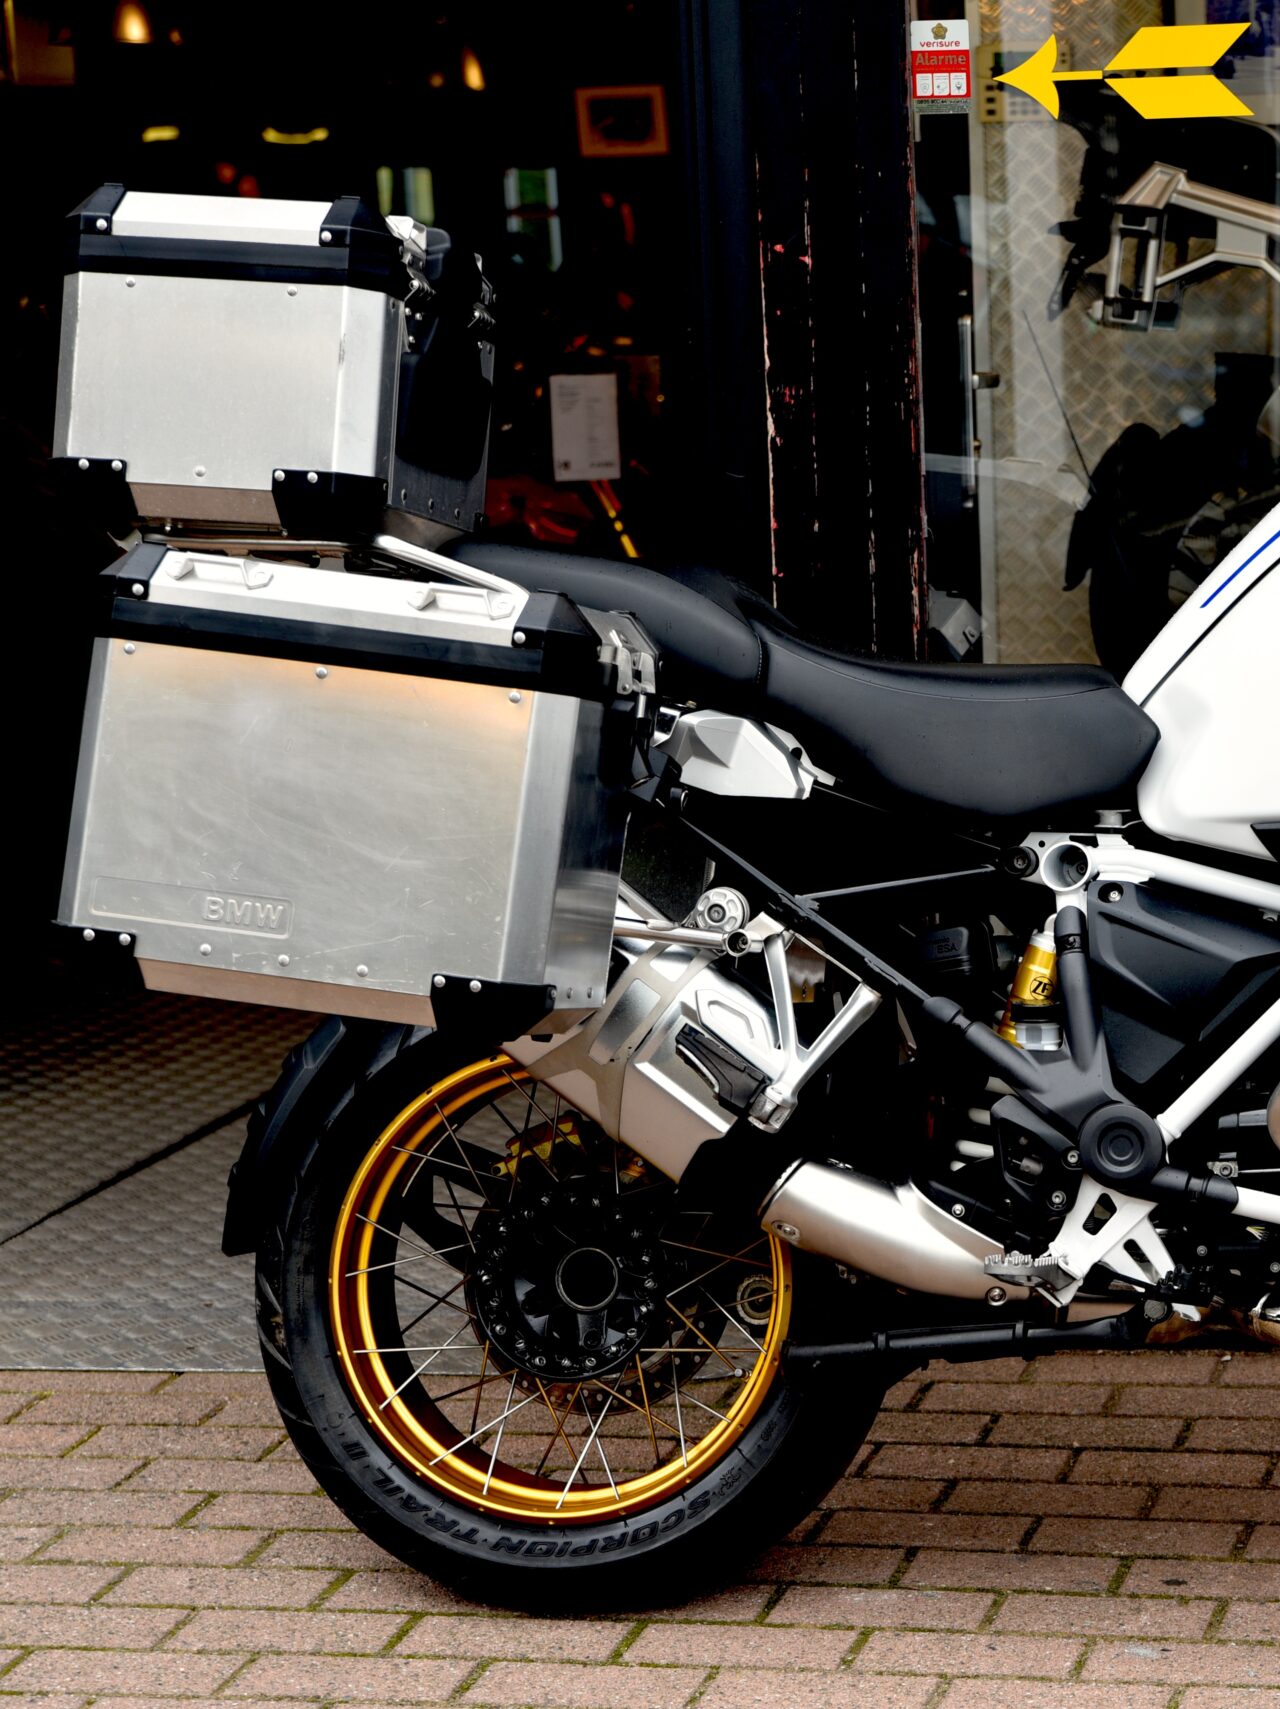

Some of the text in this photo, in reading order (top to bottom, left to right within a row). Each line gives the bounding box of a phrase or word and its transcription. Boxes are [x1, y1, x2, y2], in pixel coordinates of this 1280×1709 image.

[920, 40, 961, 48] verisure
[915, 52, 967, 66] Alarme
[203, 896, 284, 929] BMW
[937, 943, 959, 955] ESA
[372, 1467, 480, 1545] TRAIL
[489, 1490, 711, 1558] SCORPION
